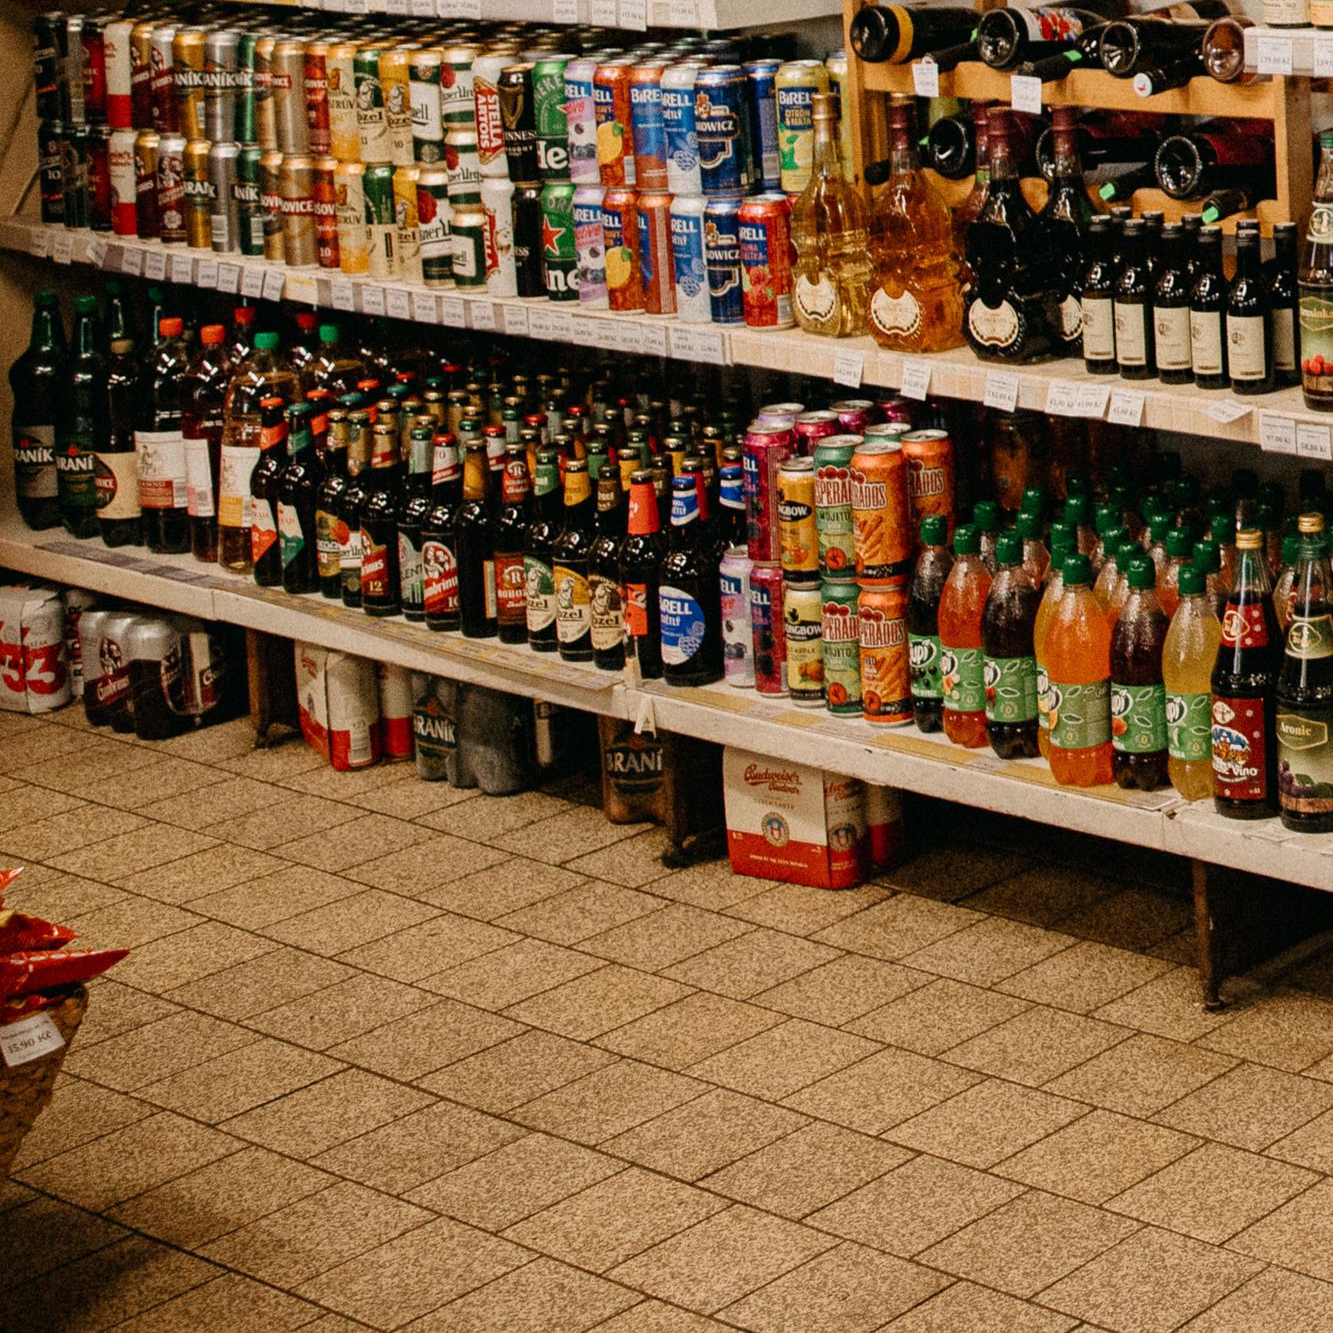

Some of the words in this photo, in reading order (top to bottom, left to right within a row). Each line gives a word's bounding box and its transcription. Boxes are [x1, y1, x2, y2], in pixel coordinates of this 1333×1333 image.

[475, 91, 488, 151] ARTOIS
[486, 93, 499, 149] STELLA
[556, 607, 583, 622] ozel
[592, 613, 620, 628] ozel
[1280, 722, 1312, 737] Aronie
[607, 748, 662, 772] BRANÍ
